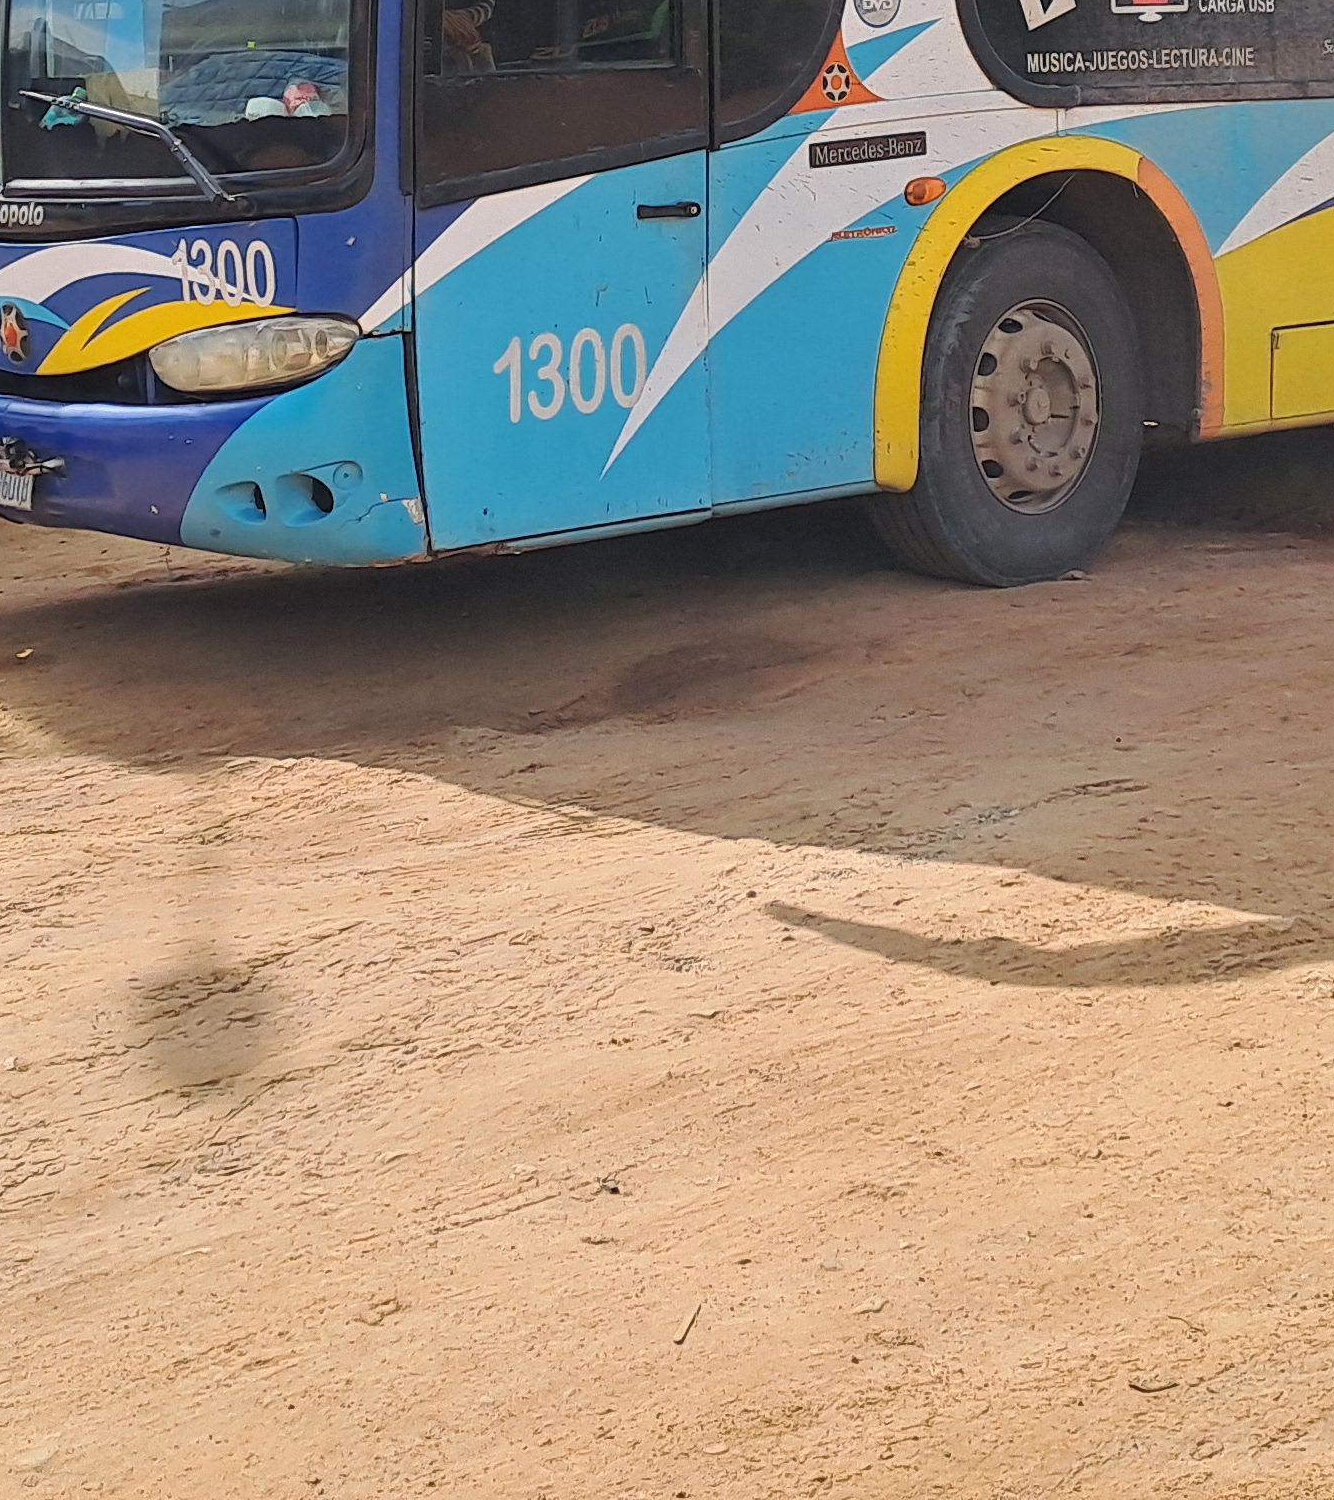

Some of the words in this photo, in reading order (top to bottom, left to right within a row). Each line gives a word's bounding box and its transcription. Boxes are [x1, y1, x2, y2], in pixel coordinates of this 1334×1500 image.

[1026, 47, 1256, 73] MUSICA-JUEGOS-LECTURA-CINE
[815, 137, 923, 166] Mercedes-Benz
[172, 238, 276, 308] 1300
[493, 322, 648, 424] 1300
